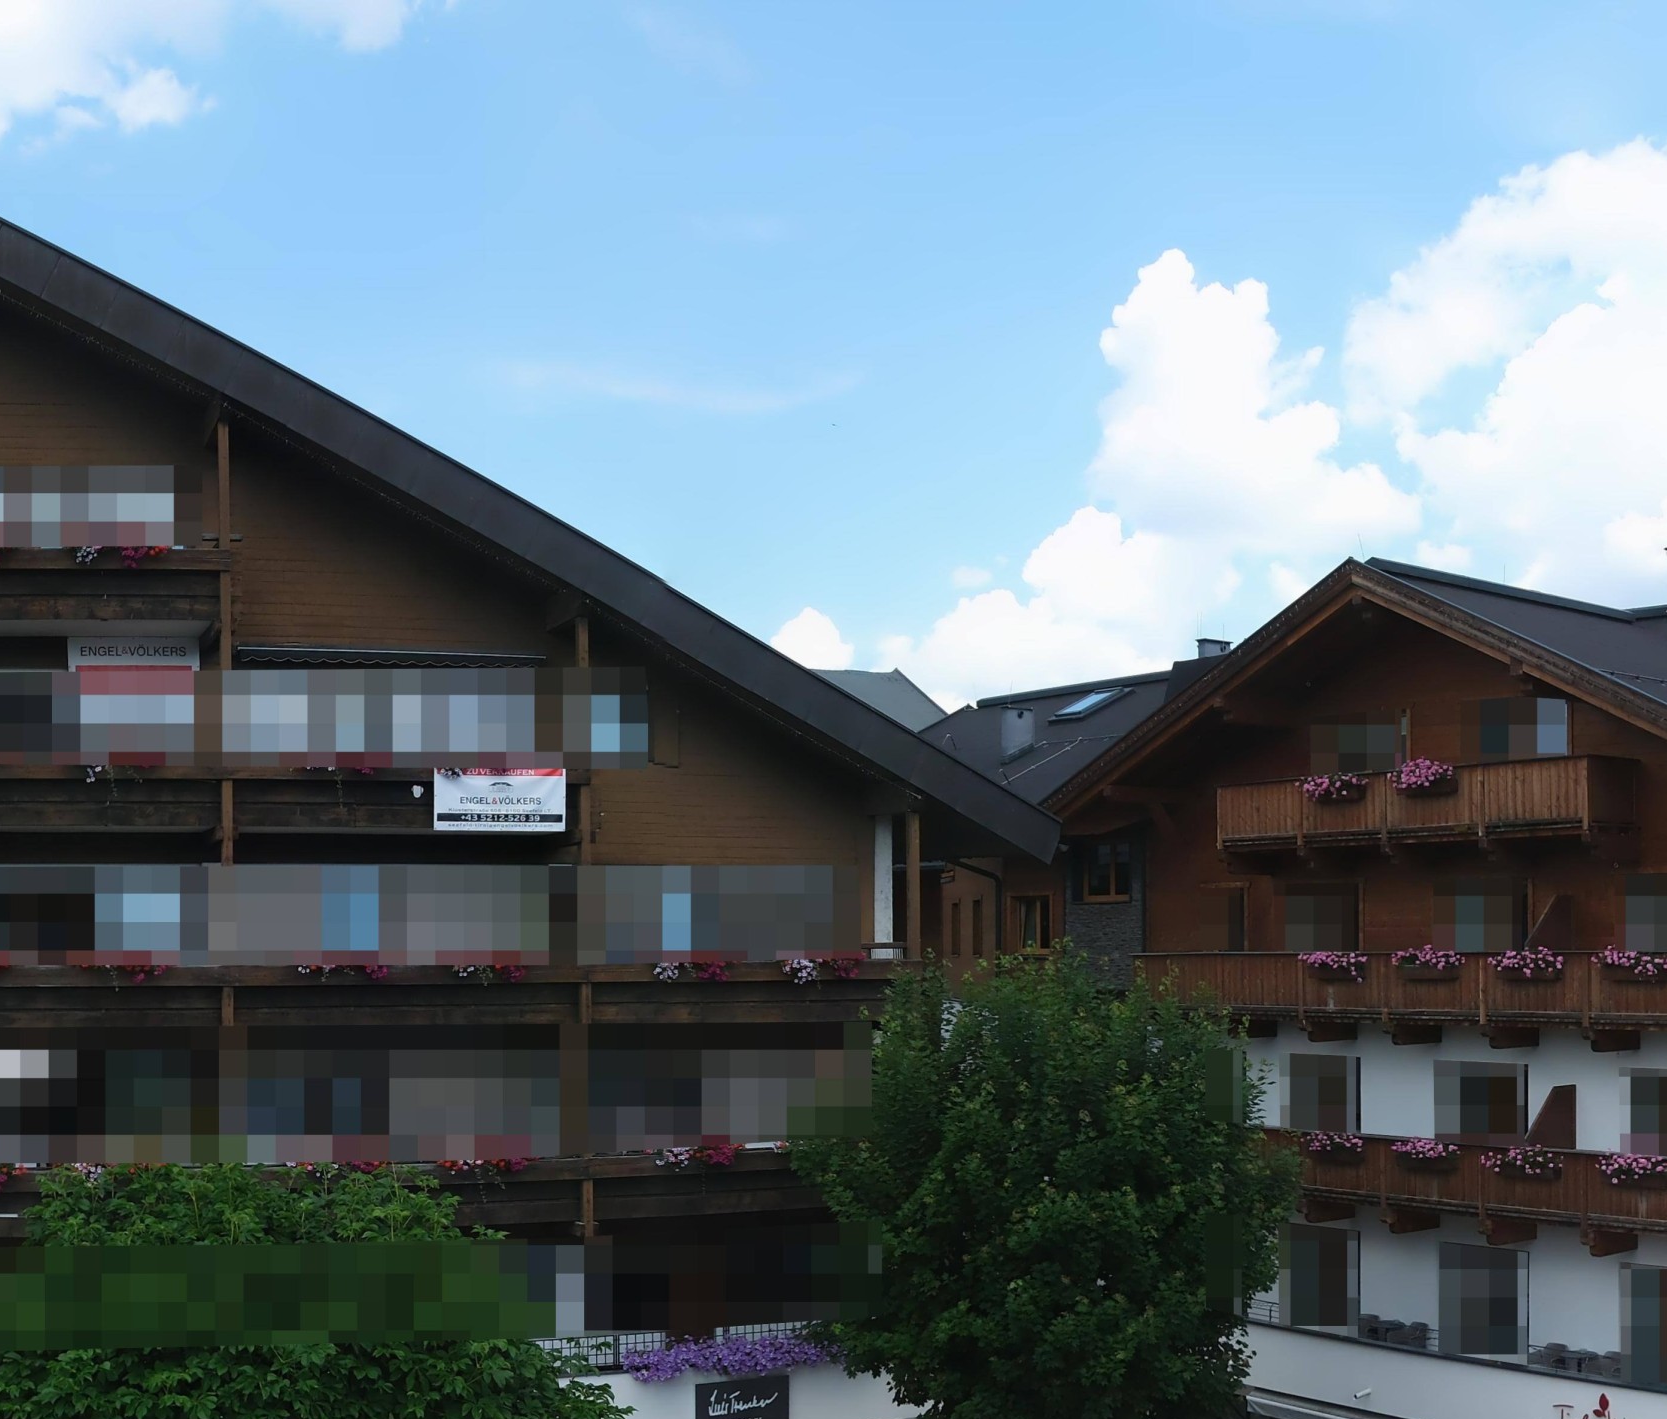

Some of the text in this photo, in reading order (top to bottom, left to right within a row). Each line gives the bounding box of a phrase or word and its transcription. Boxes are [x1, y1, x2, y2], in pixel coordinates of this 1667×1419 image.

[80, 644, 186, 657] ENGEL&VÖLKERS
[459, 795, 542, 806] ENGEL&VÖLKERS
[480, 814, 526, 822] 5212-526
[528, 814, 540, 822] 39
